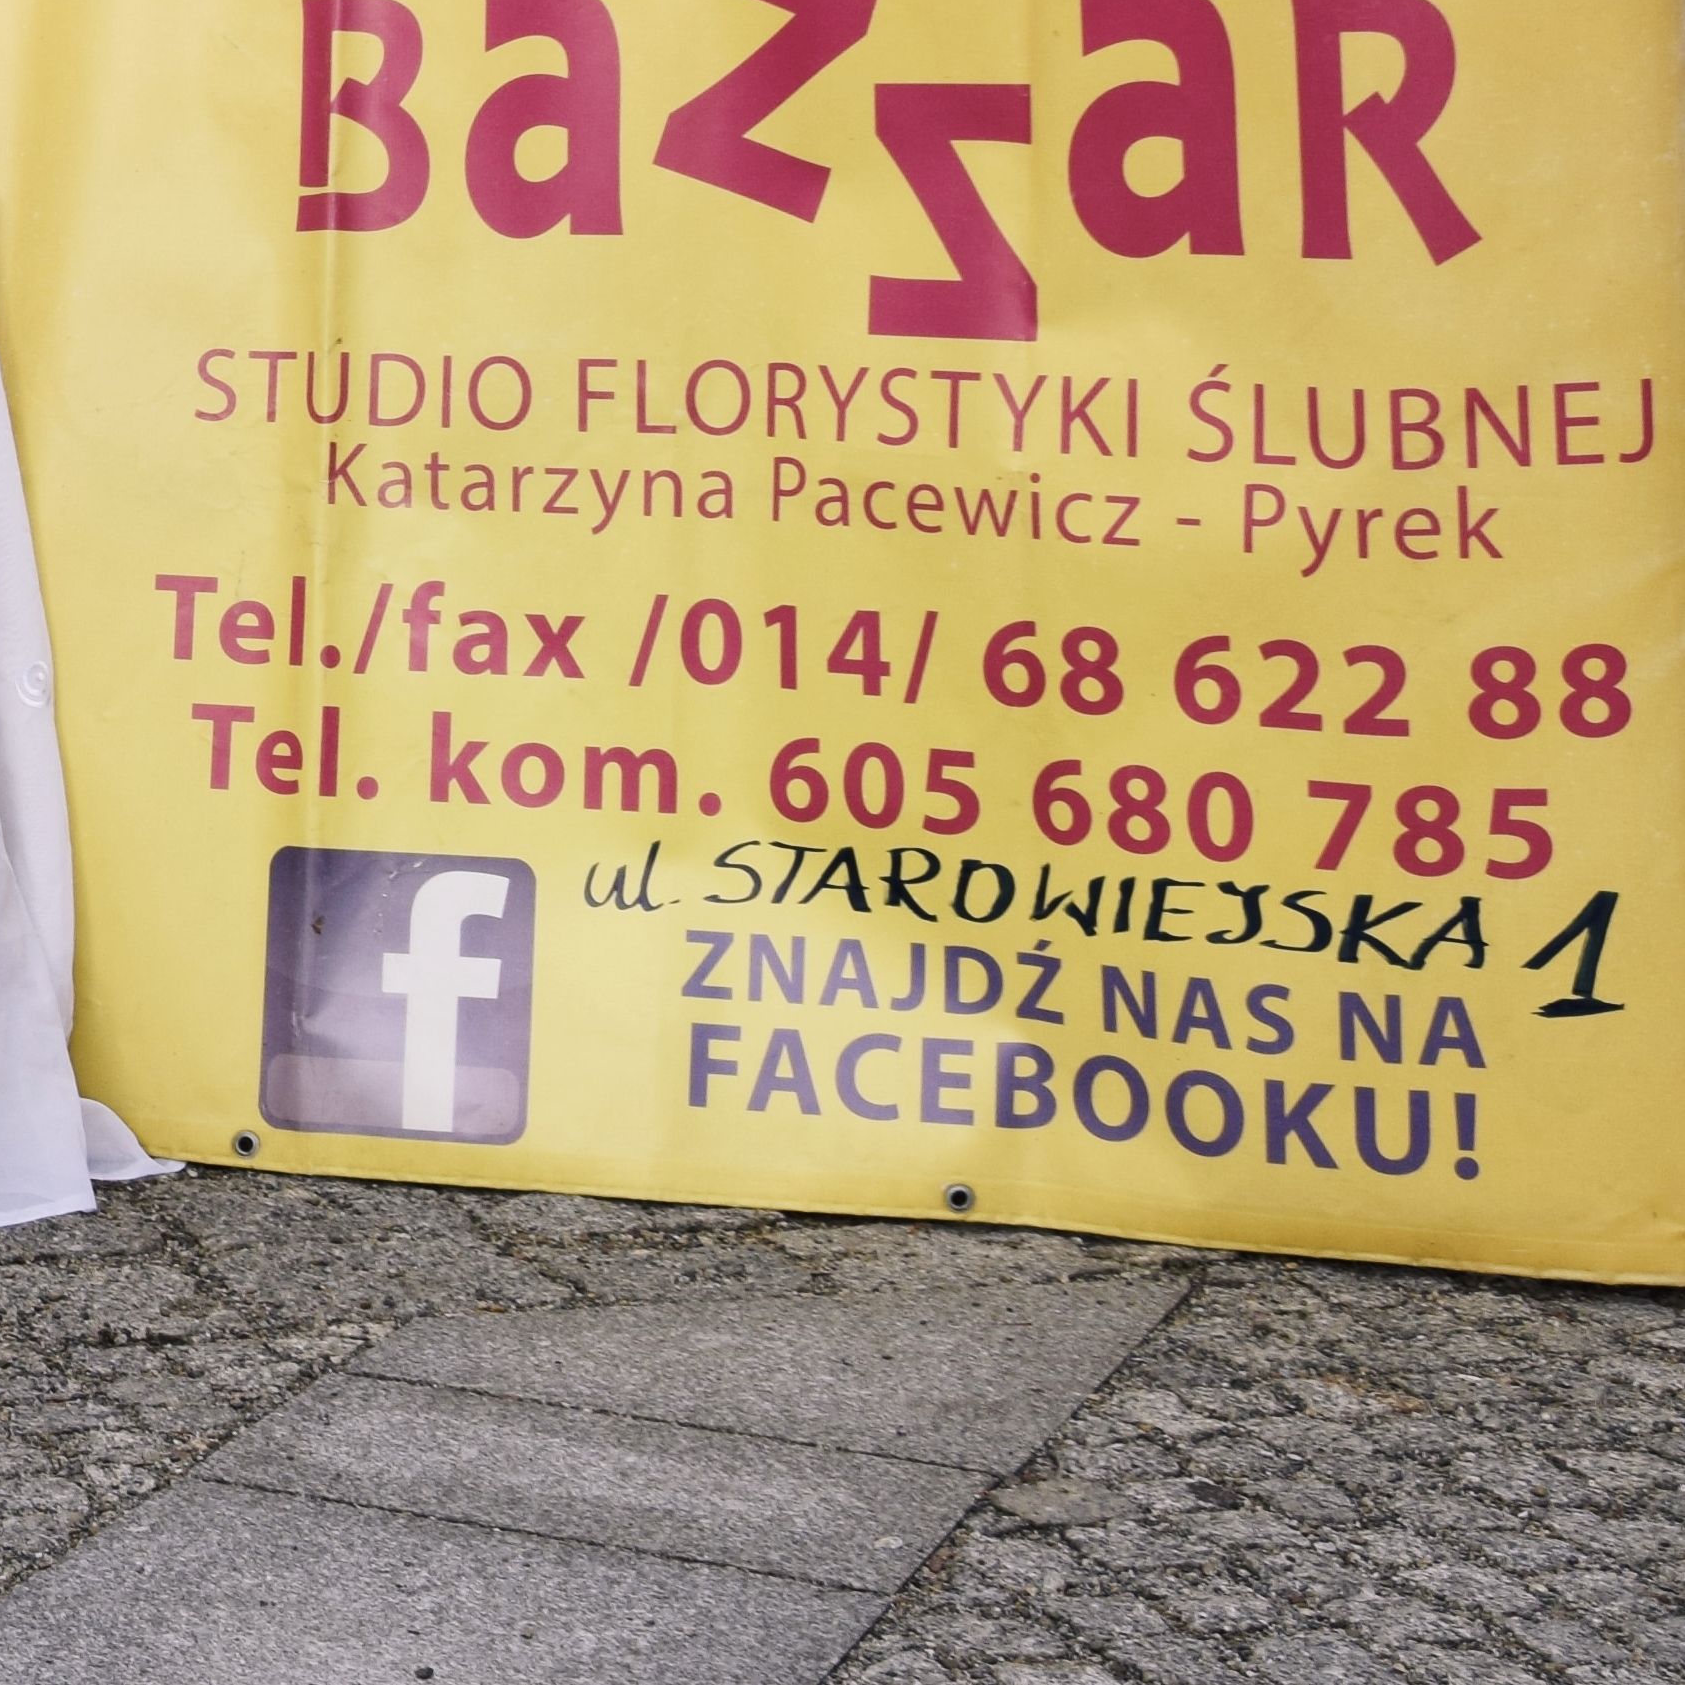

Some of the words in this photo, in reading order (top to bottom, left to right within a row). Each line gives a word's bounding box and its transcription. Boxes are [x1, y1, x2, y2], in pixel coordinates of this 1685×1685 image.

[194, 350, 533, 432] STUDIO
[577, 358, 1137, 459] FLORYSTYKI
[1187, 363, 1655, 471] ŚLUBNEJ
[326, 441, 733, 534] Katarzyna
[772, 456, 1140, 547] Pacewicz
[1242, 482, 1504, 578] Pyrek
[155, 574, 585, 679] Tel./fax
[630, 594, 939, 707] /014/
[982, 619, 1126, 717] 68
[1173, 634, 1410, 739] 622
[1467, 643, 1634, 740] 88
[191, 702, 379, 801] Tel.
[429, 710, 723, 818] kom.
[769, 736, 981, 837] 605
[1032, 758, 1254, 864] 680
[1307, 779, 1554, 881] 785
[681, 929, 1065, 1025] ZNAJDŹ
[1101, 964, 1295, 1056] NAS
[1338, 991, 1487, 1069] NA
[703, 840, 1490, 971] STAROWIEJSKA
[1520, 889, 1625, 1019] 1
[687, 1021, 1480, 1182] FACEBOOKU!
